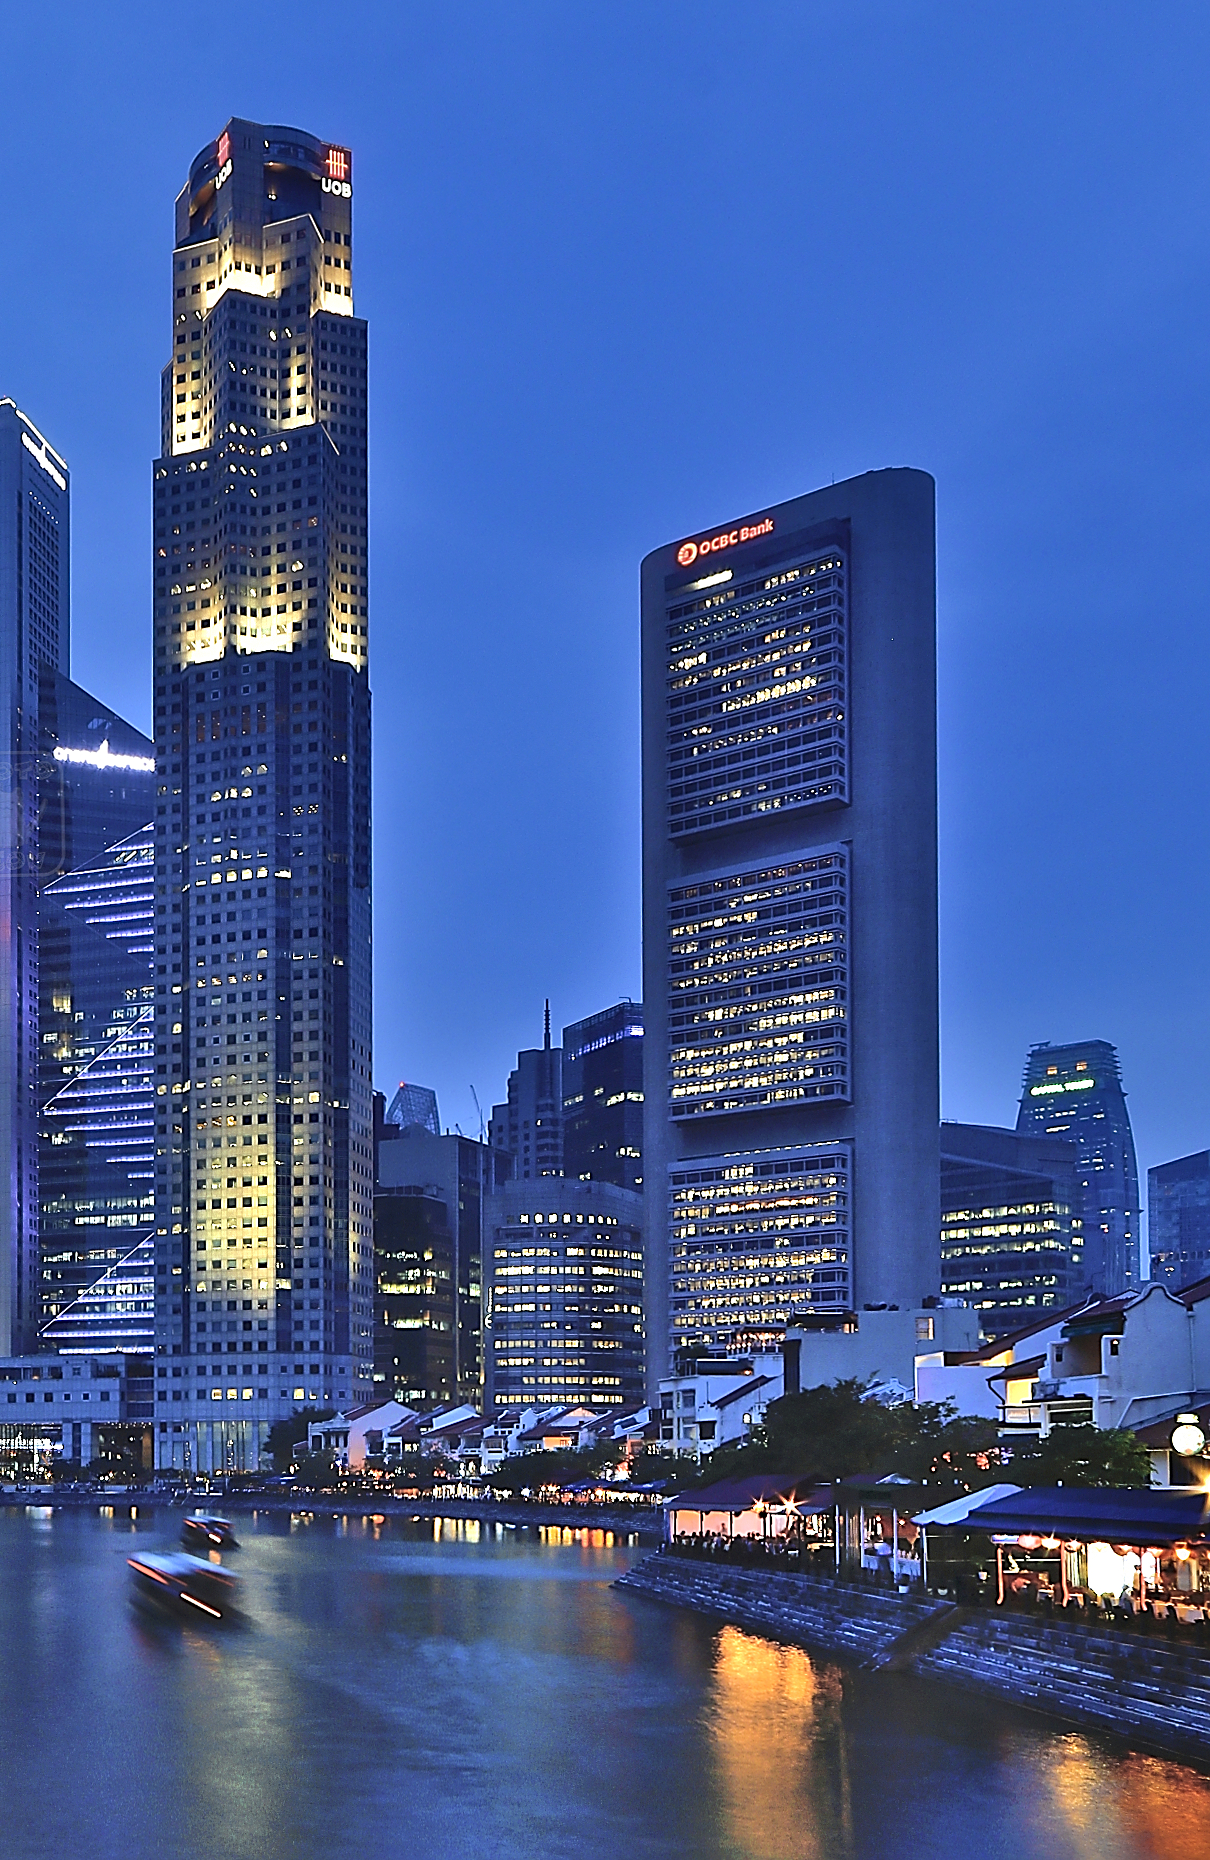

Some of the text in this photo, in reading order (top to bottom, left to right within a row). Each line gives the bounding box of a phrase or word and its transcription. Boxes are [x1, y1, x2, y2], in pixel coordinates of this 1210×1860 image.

[321, 177, 352, 199] UOB
[699, 518, 774, 556] OCBC Bank
